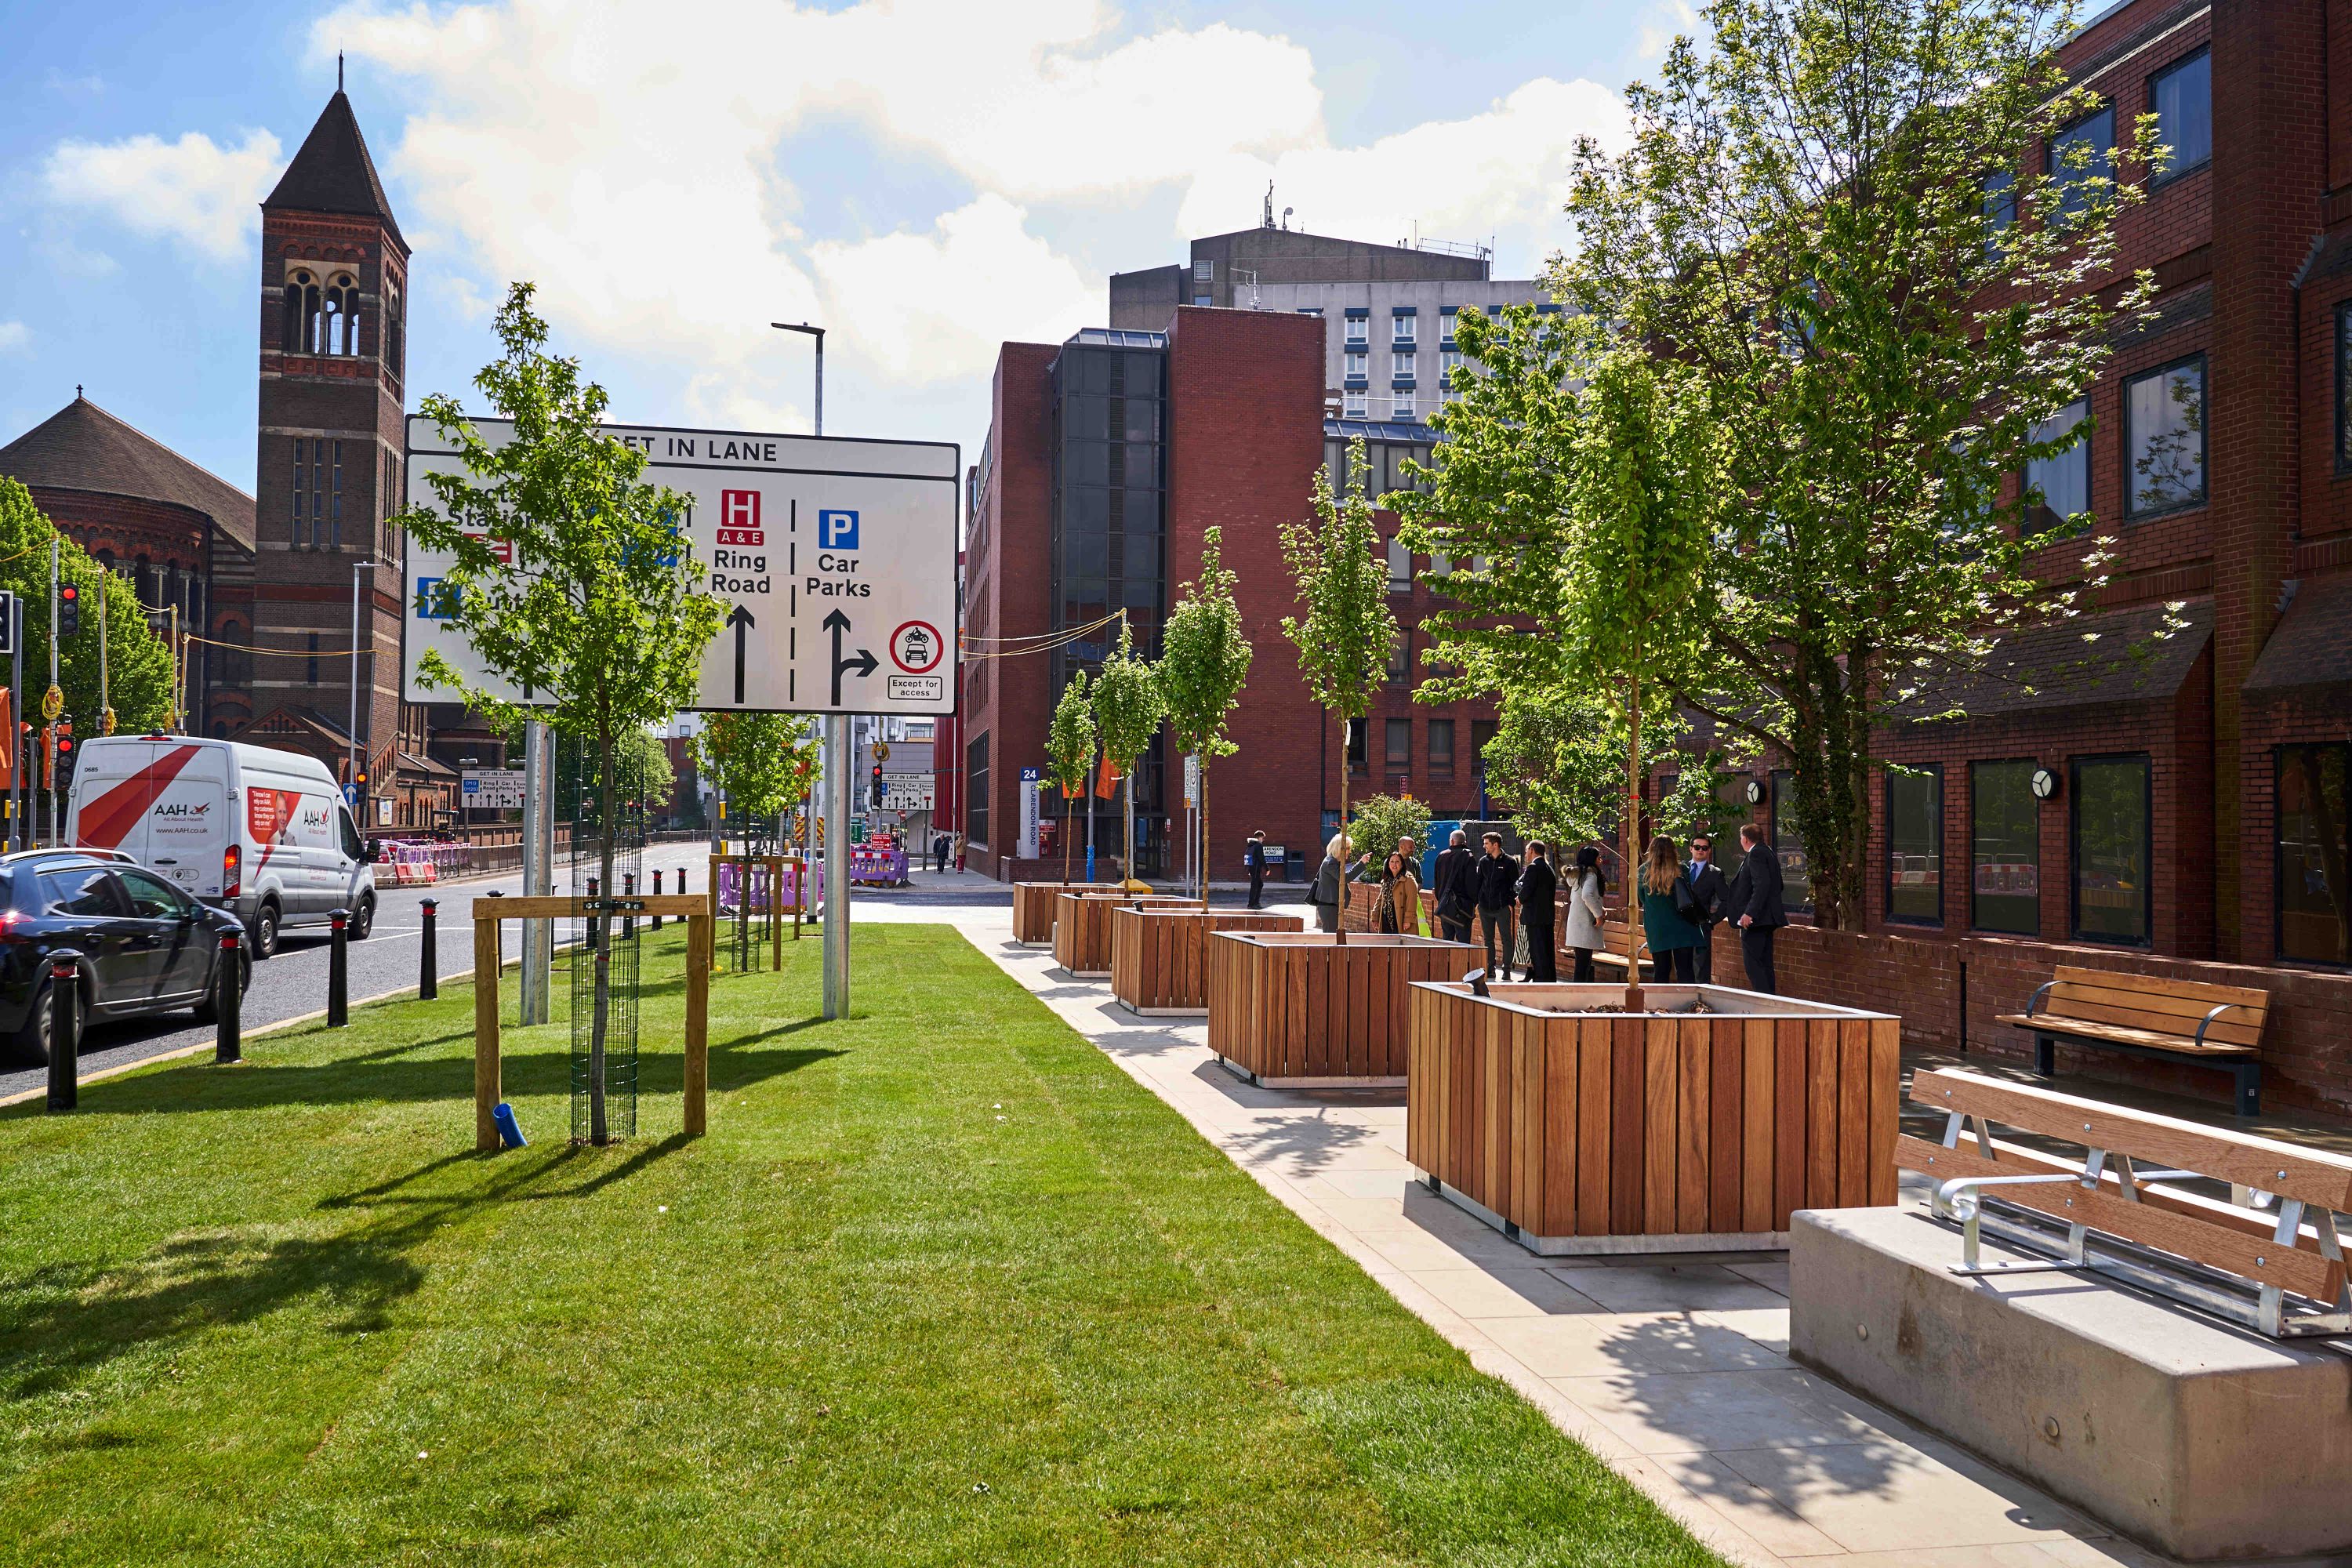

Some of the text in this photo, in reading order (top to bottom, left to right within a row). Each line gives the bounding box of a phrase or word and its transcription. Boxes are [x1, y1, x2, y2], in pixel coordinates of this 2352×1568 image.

[669, 438, 695, 457] IN
[709, 441, 777, 462] LANE
[448, 508, 538, 528] Staion
[728, 493, 754, 525] H
[721, 532, 760, 543] A & E
[829, 514, 852, 546] P
[715, 550, 766, 573] Ring
[818, 554, 859, 573] Car
[712, 574, 771, 593] Road
[807, 577, 871, 597] Parks
[892, 680, 922, 688] Except
[1023, 769, 1036, 779] 24
[154, 804, 187, 815] AAH
[304, 809, 319, 827] AAH
